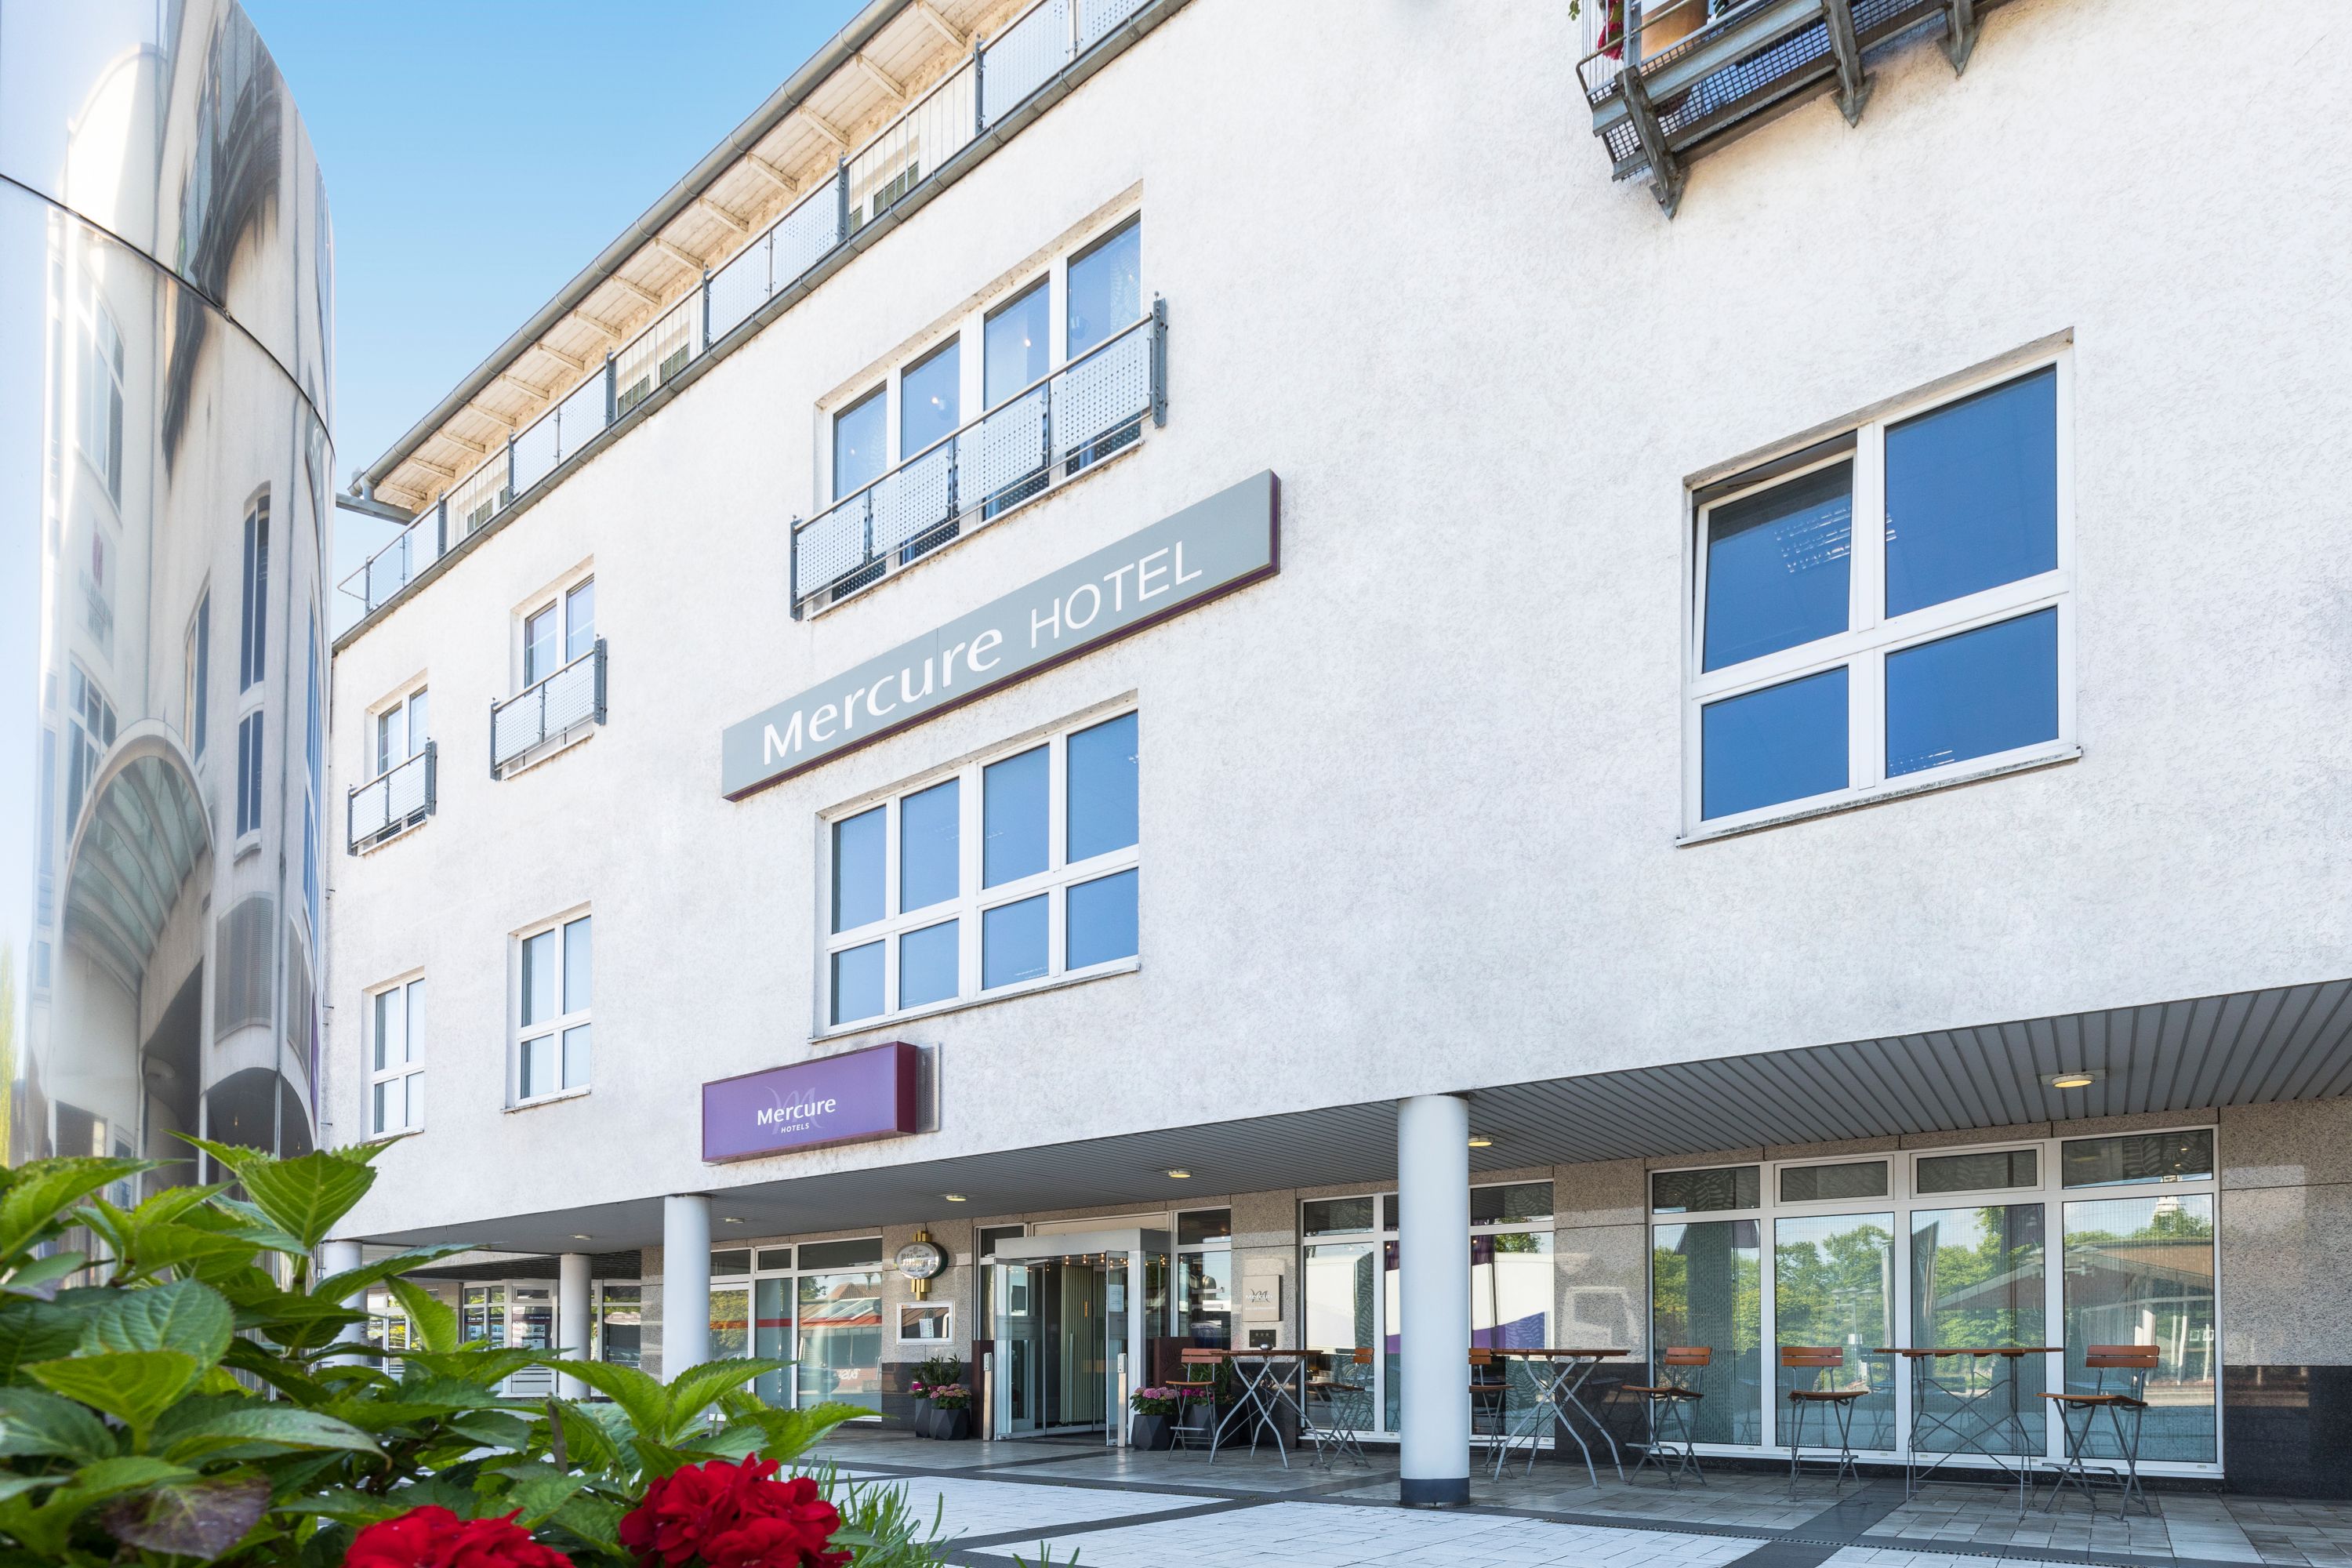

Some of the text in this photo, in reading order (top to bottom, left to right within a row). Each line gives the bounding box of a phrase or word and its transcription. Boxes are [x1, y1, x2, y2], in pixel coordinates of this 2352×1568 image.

[764, 541, 1203, 766] Mercure HOTEL
[757, 1098, 837, 1126] Mercure
[781, 1123, 810, 1134] HOTELS
